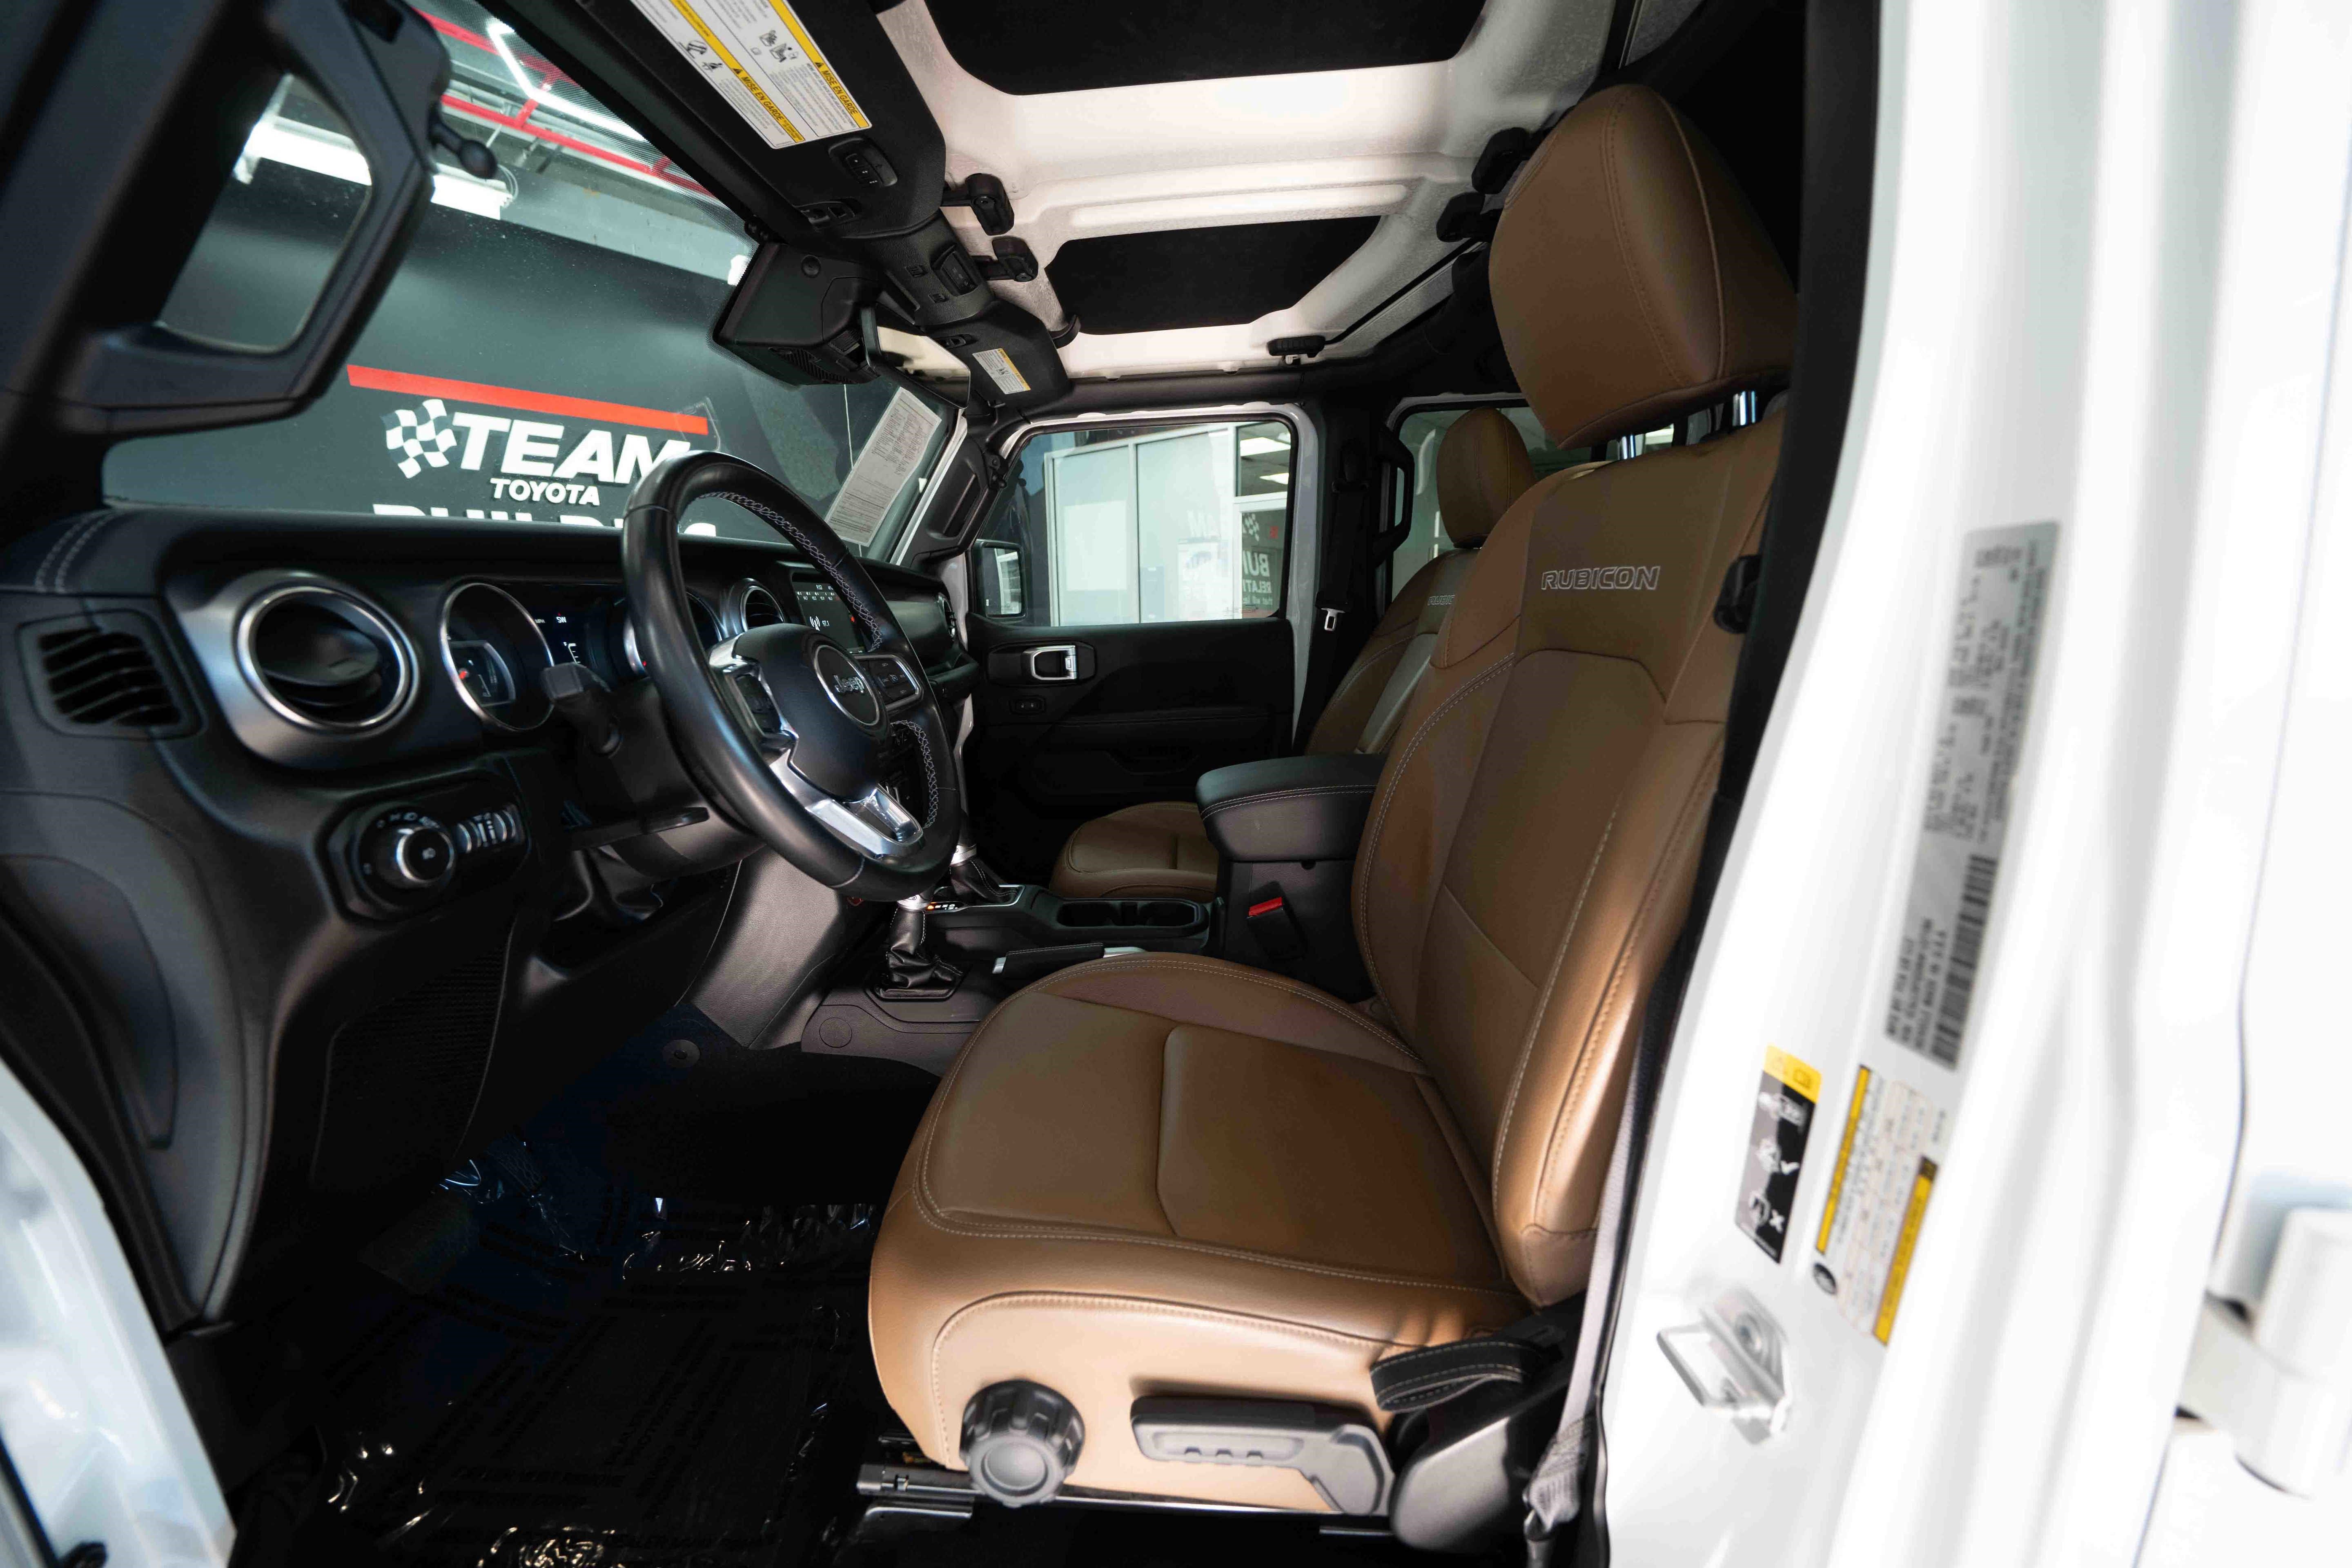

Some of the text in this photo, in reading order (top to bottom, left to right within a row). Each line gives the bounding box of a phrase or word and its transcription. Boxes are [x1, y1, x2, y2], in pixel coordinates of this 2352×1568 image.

[742, 76, 784, 121] MISE EN GARDE
[822, 70, 858, 114] MISE EN GARDE
[490, 478, 600, 506] TOYOTA
[1541, 566, 1661, 590] RUBICON
[833, 675, 865, 694] Jeep
